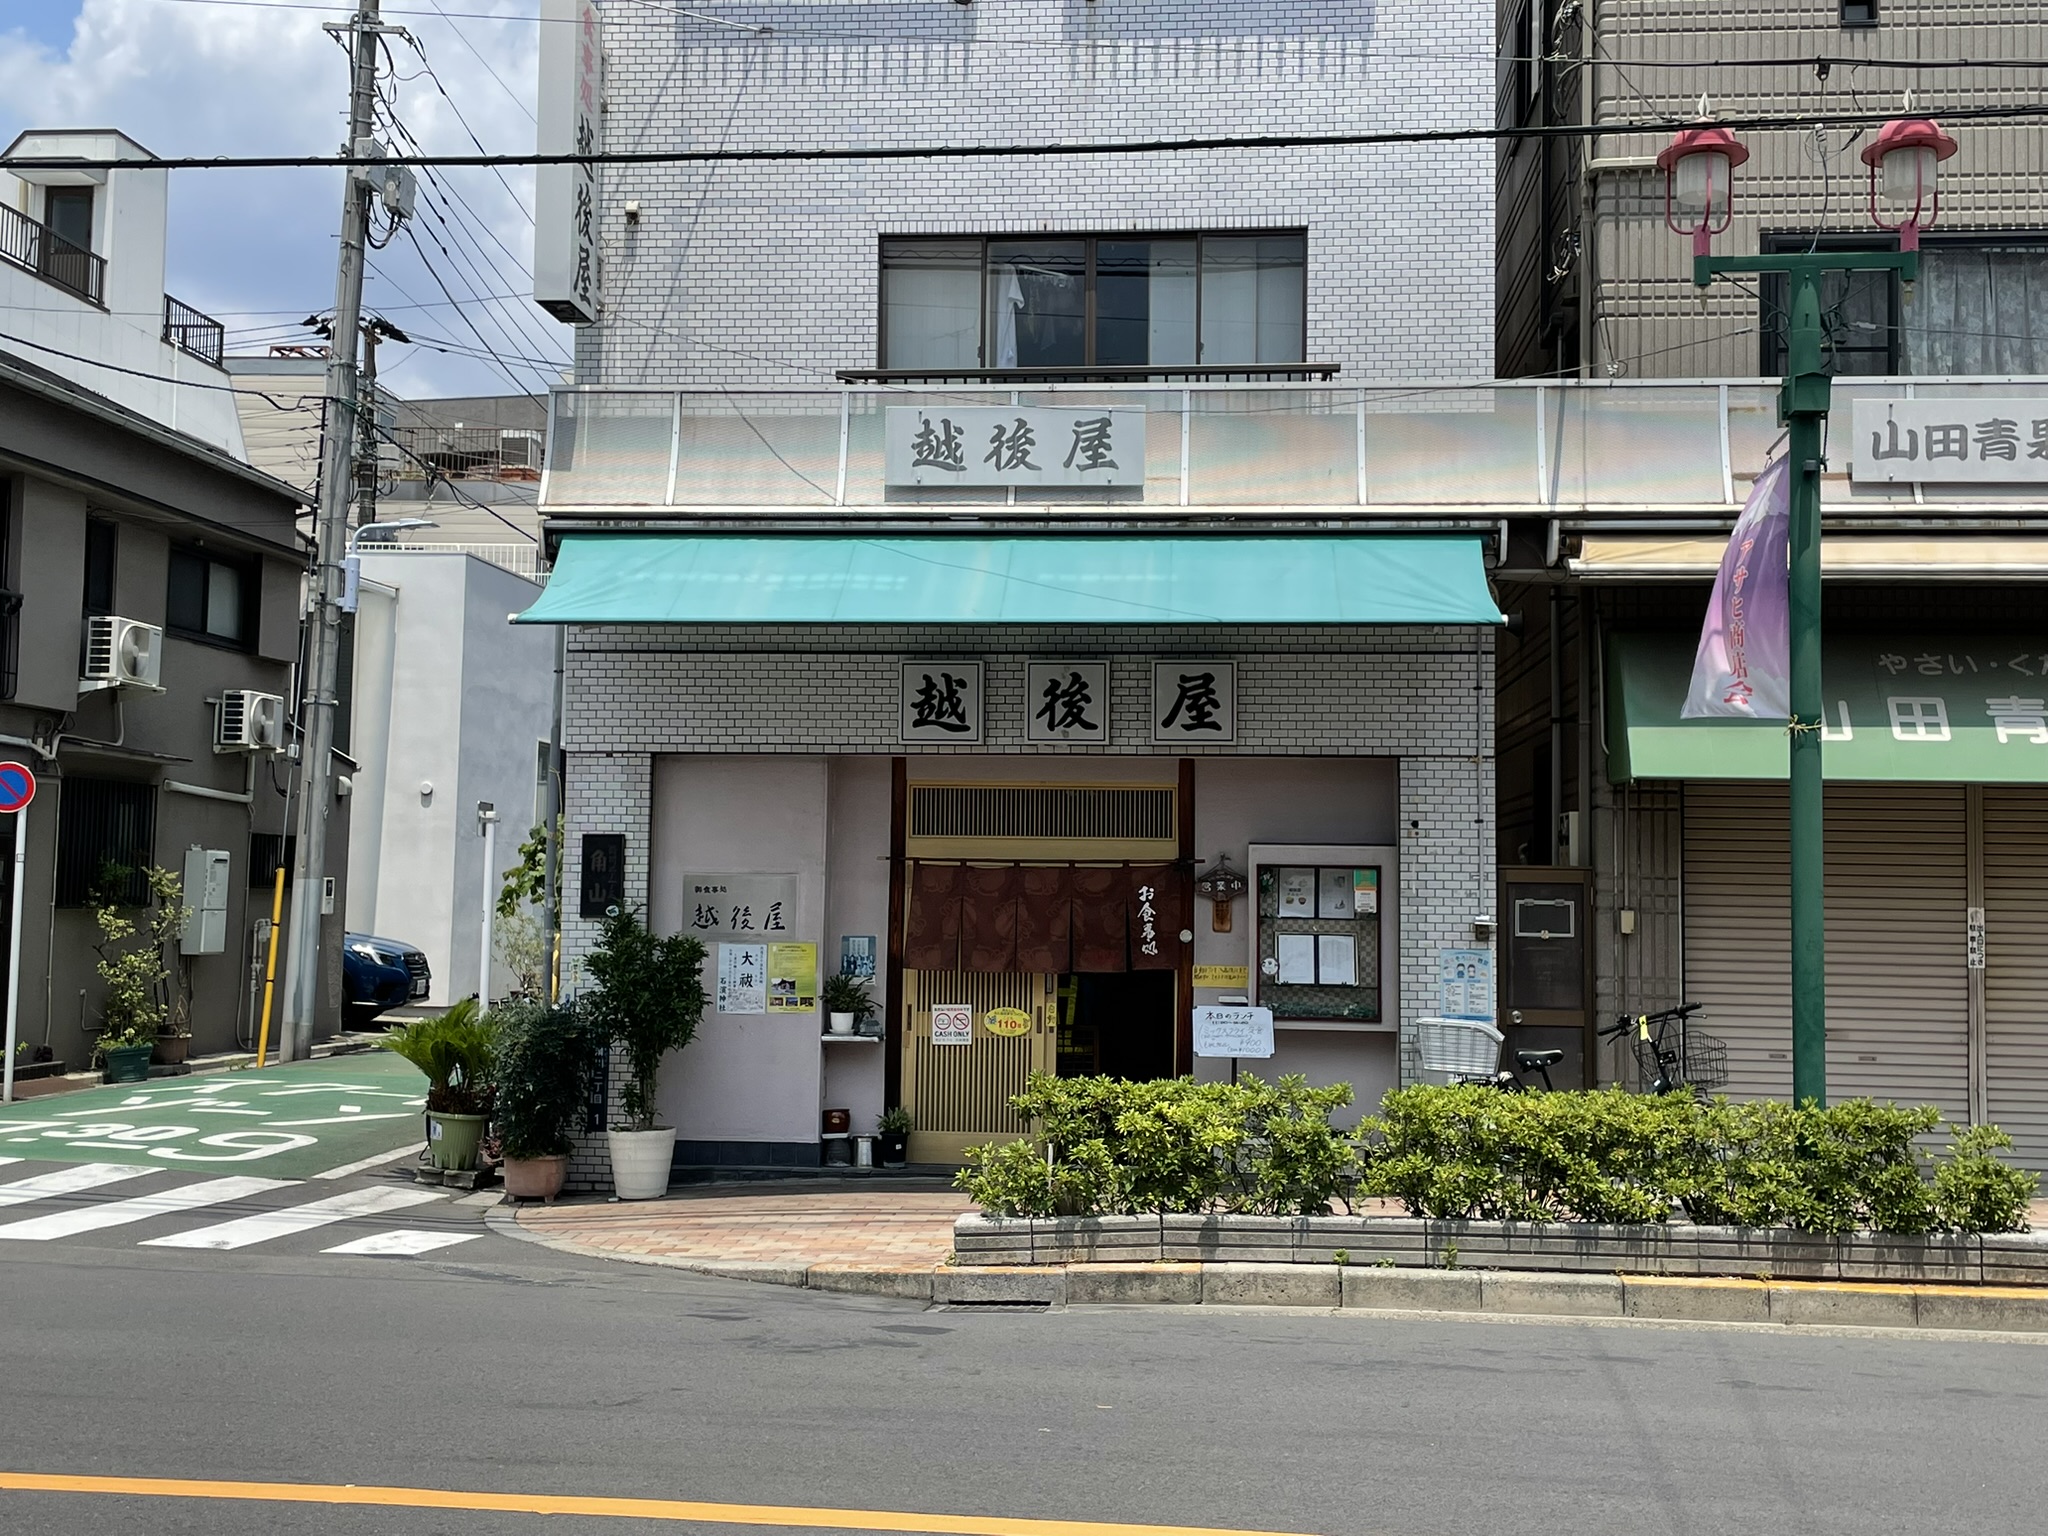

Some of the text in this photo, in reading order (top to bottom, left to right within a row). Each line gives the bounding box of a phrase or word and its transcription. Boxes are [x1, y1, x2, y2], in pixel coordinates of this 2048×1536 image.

[573, 114, 595, 308] 越後屋
[911, 417, 1120, 472] 越後屋
[1722, 538, 1753, 705] アサヒ商店会
[910, 672, 1222, 732] 越後屋
[691, 901, 786, 930] 越後屋
[1137, 885, 1158, 956] お食事処
[739, 950, 755, 988] 大祓
[1205, 1011, 1254, 1020] 本日のランチ
